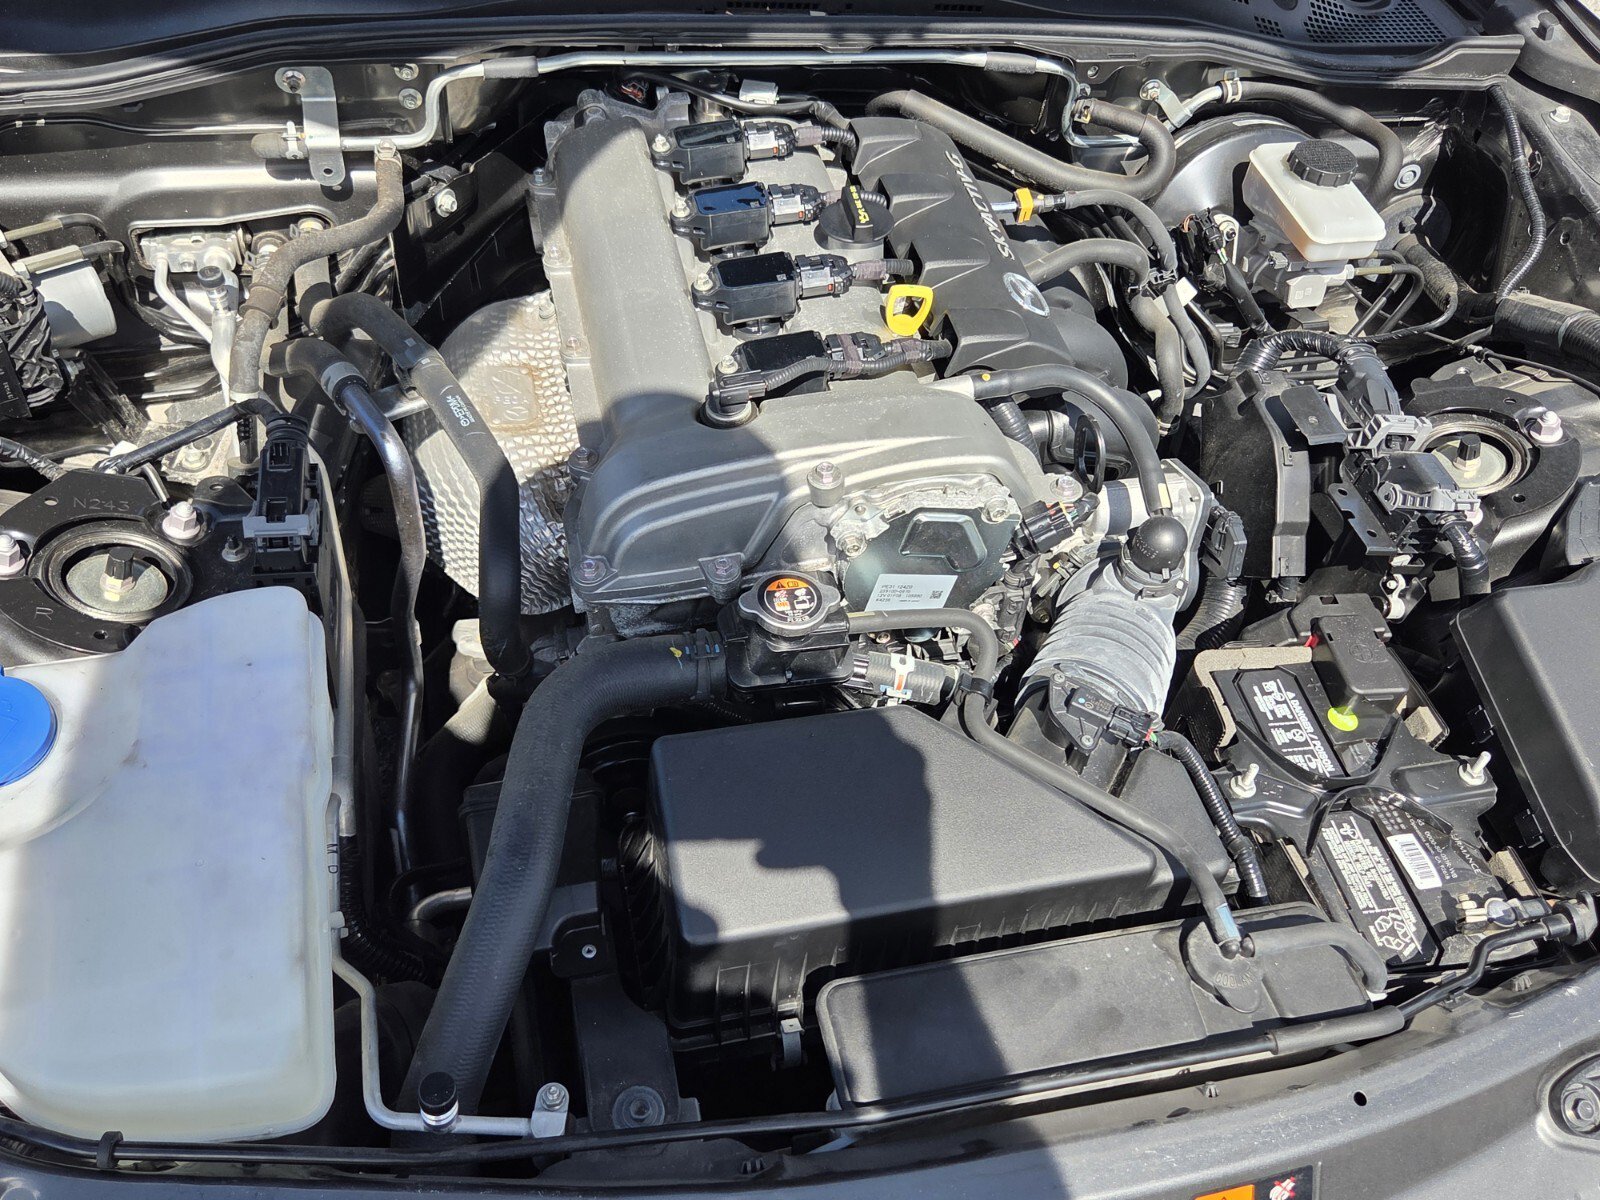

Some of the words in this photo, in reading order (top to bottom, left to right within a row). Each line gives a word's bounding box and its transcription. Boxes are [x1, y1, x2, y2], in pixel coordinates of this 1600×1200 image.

[945, 150, 1015, 261] SKYACTIV-G
[73, 497, 130, 511] N243
[33, 606, 54, 620] R
[1290, 699, 1315, 735] DANGER
[1310, 739, 1336, 773] POISON
